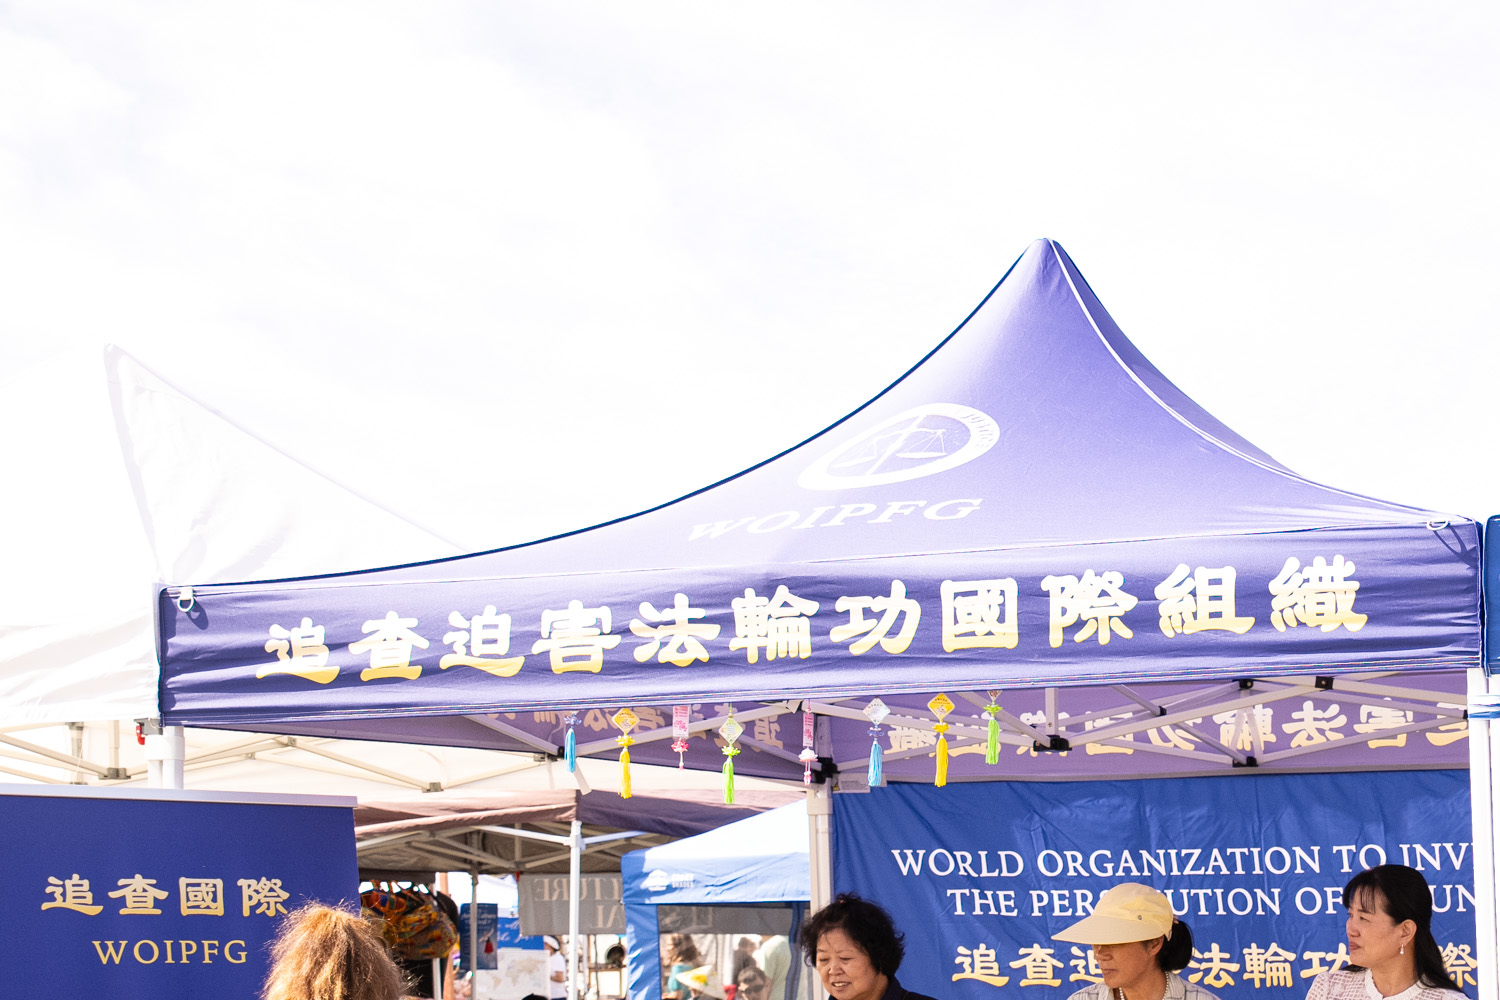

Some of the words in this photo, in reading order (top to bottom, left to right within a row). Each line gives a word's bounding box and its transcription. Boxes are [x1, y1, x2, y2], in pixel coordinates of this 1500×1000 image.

[688, 499, 983, 541] WOIPFG
[256, 554, 1370, 685] 追查迫害法輪功國際組織
[891, 849, 1024, 877] WORLD
[1036, 845, 1321, 877] ORGANIZATION
[1333, 844, 1386, 873] TO
[41, 873, 290, 917] 追查國際
[946, 888, 1018, 916] THE
[1029, 888, 1281, 917] PERUTION
[1295, 888, 1344, 914] OF
[93, 939, 248, 964] WOIPFG
